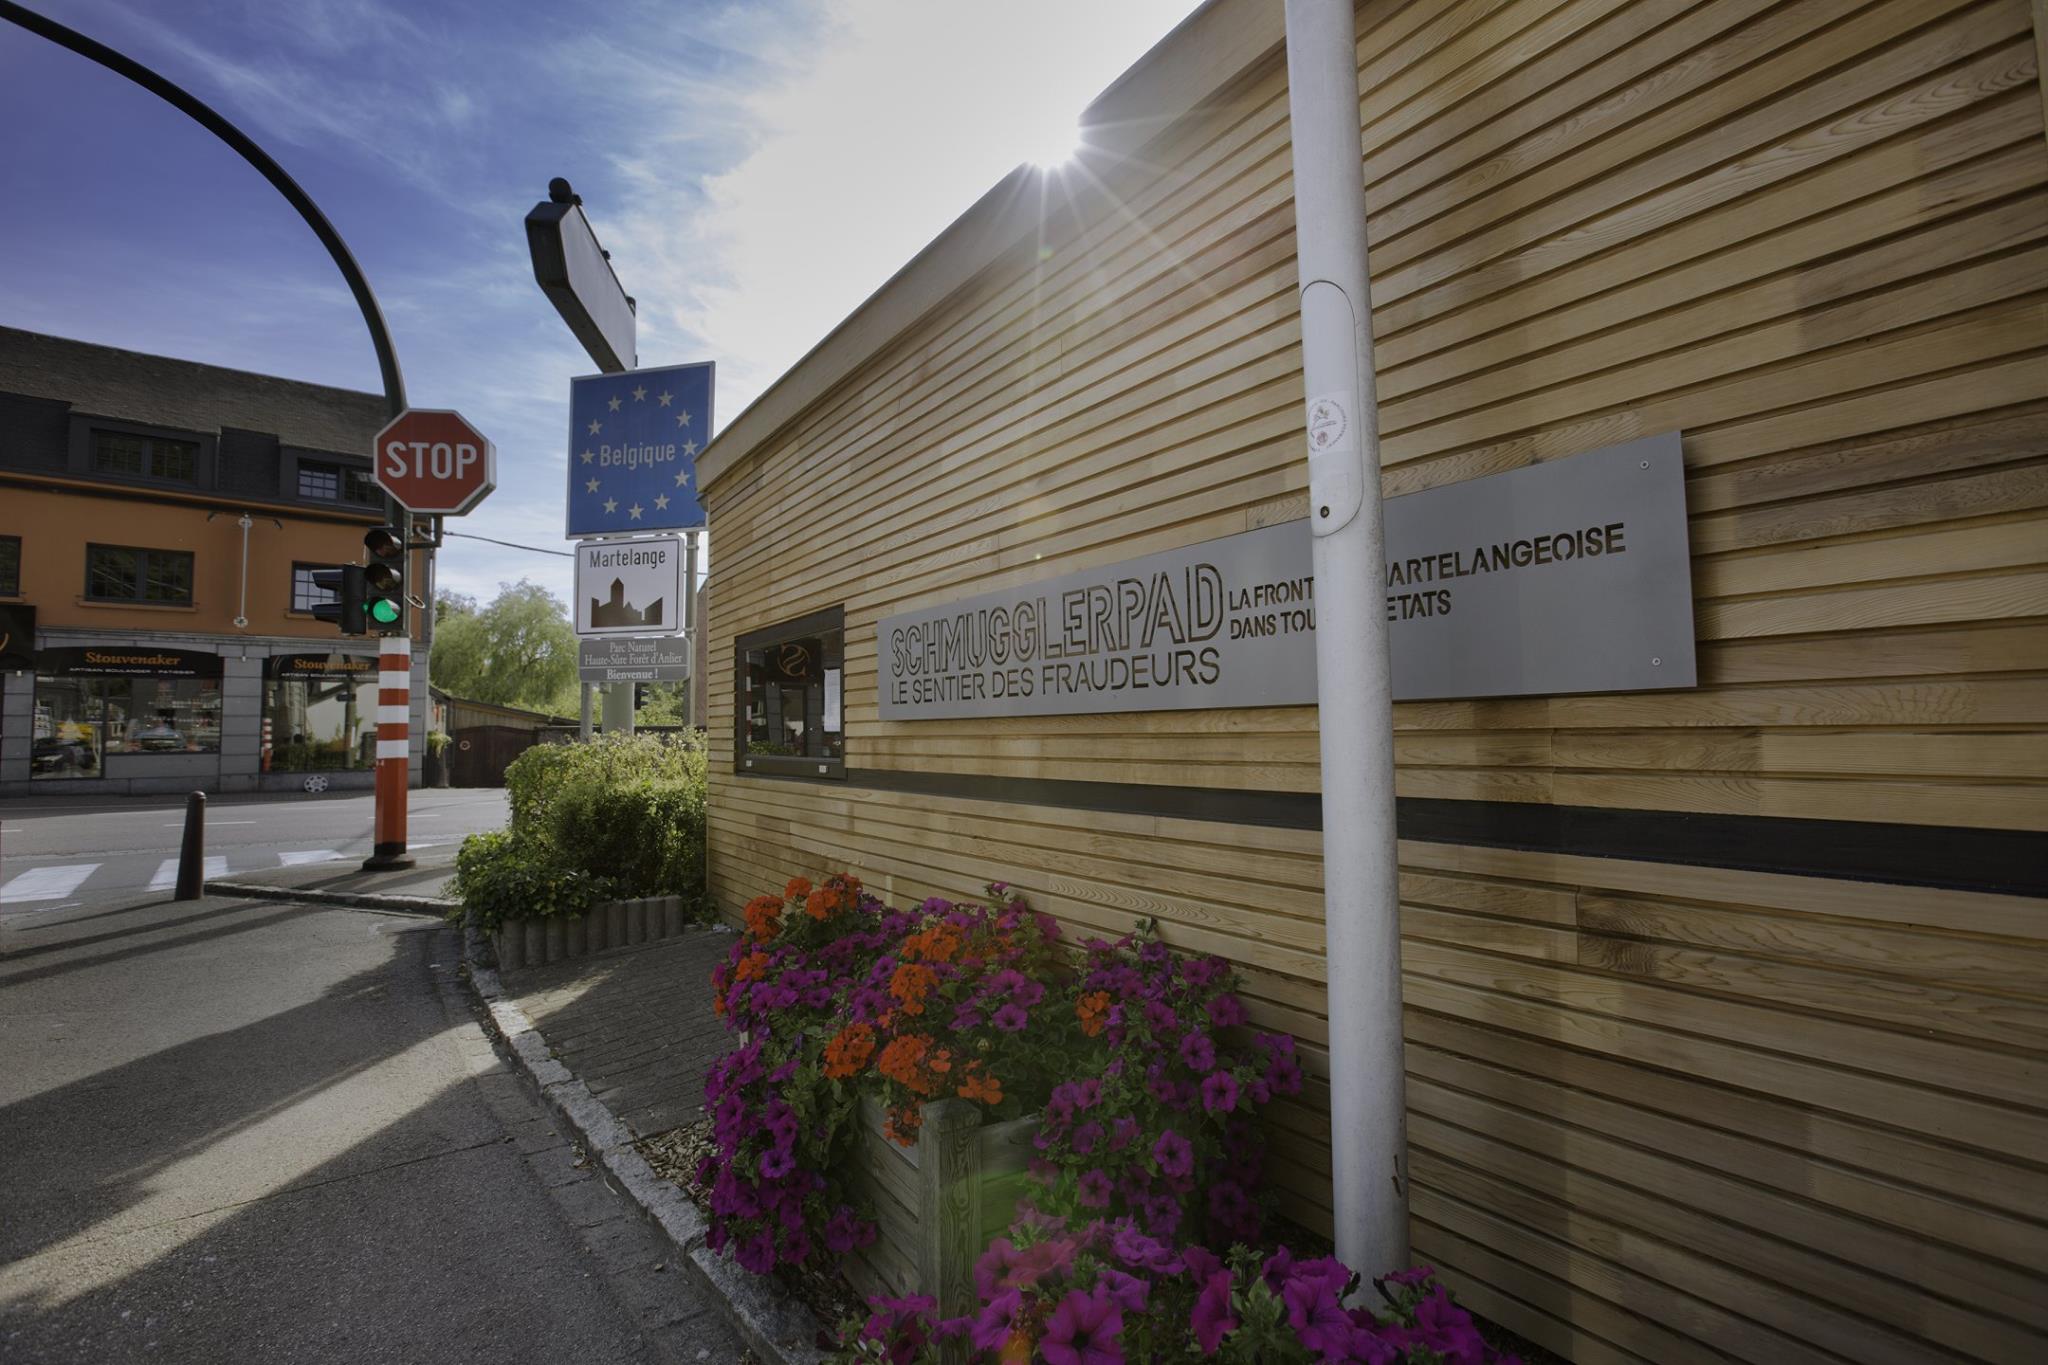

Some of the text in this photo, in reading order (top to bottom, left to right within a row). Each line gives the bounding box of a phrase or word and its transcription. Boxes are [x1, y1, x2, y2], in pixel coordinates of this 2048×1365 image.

[385, 441, 478, 480] STOP
[600, 441, 676, 470] Belgique
[589, 548, 666, 569] Martelange
[1229, 522, 1626, 611] LA FRONT ARTELANGEOISE
[891, 562, 1224, 678] SCHMUGGLERPAD
[1230, 614, 1277, 640] DANS
[1280, 608, 1317, 634] TOU
[85, 650, 181, 665] Stouvenaker
[609, 640, 657, 653] Parc Naturel
[606, 668, 654, 680] Bienvenue
[891, 646, 1220, 705] LE SENTIER DES FRAUDEURS
